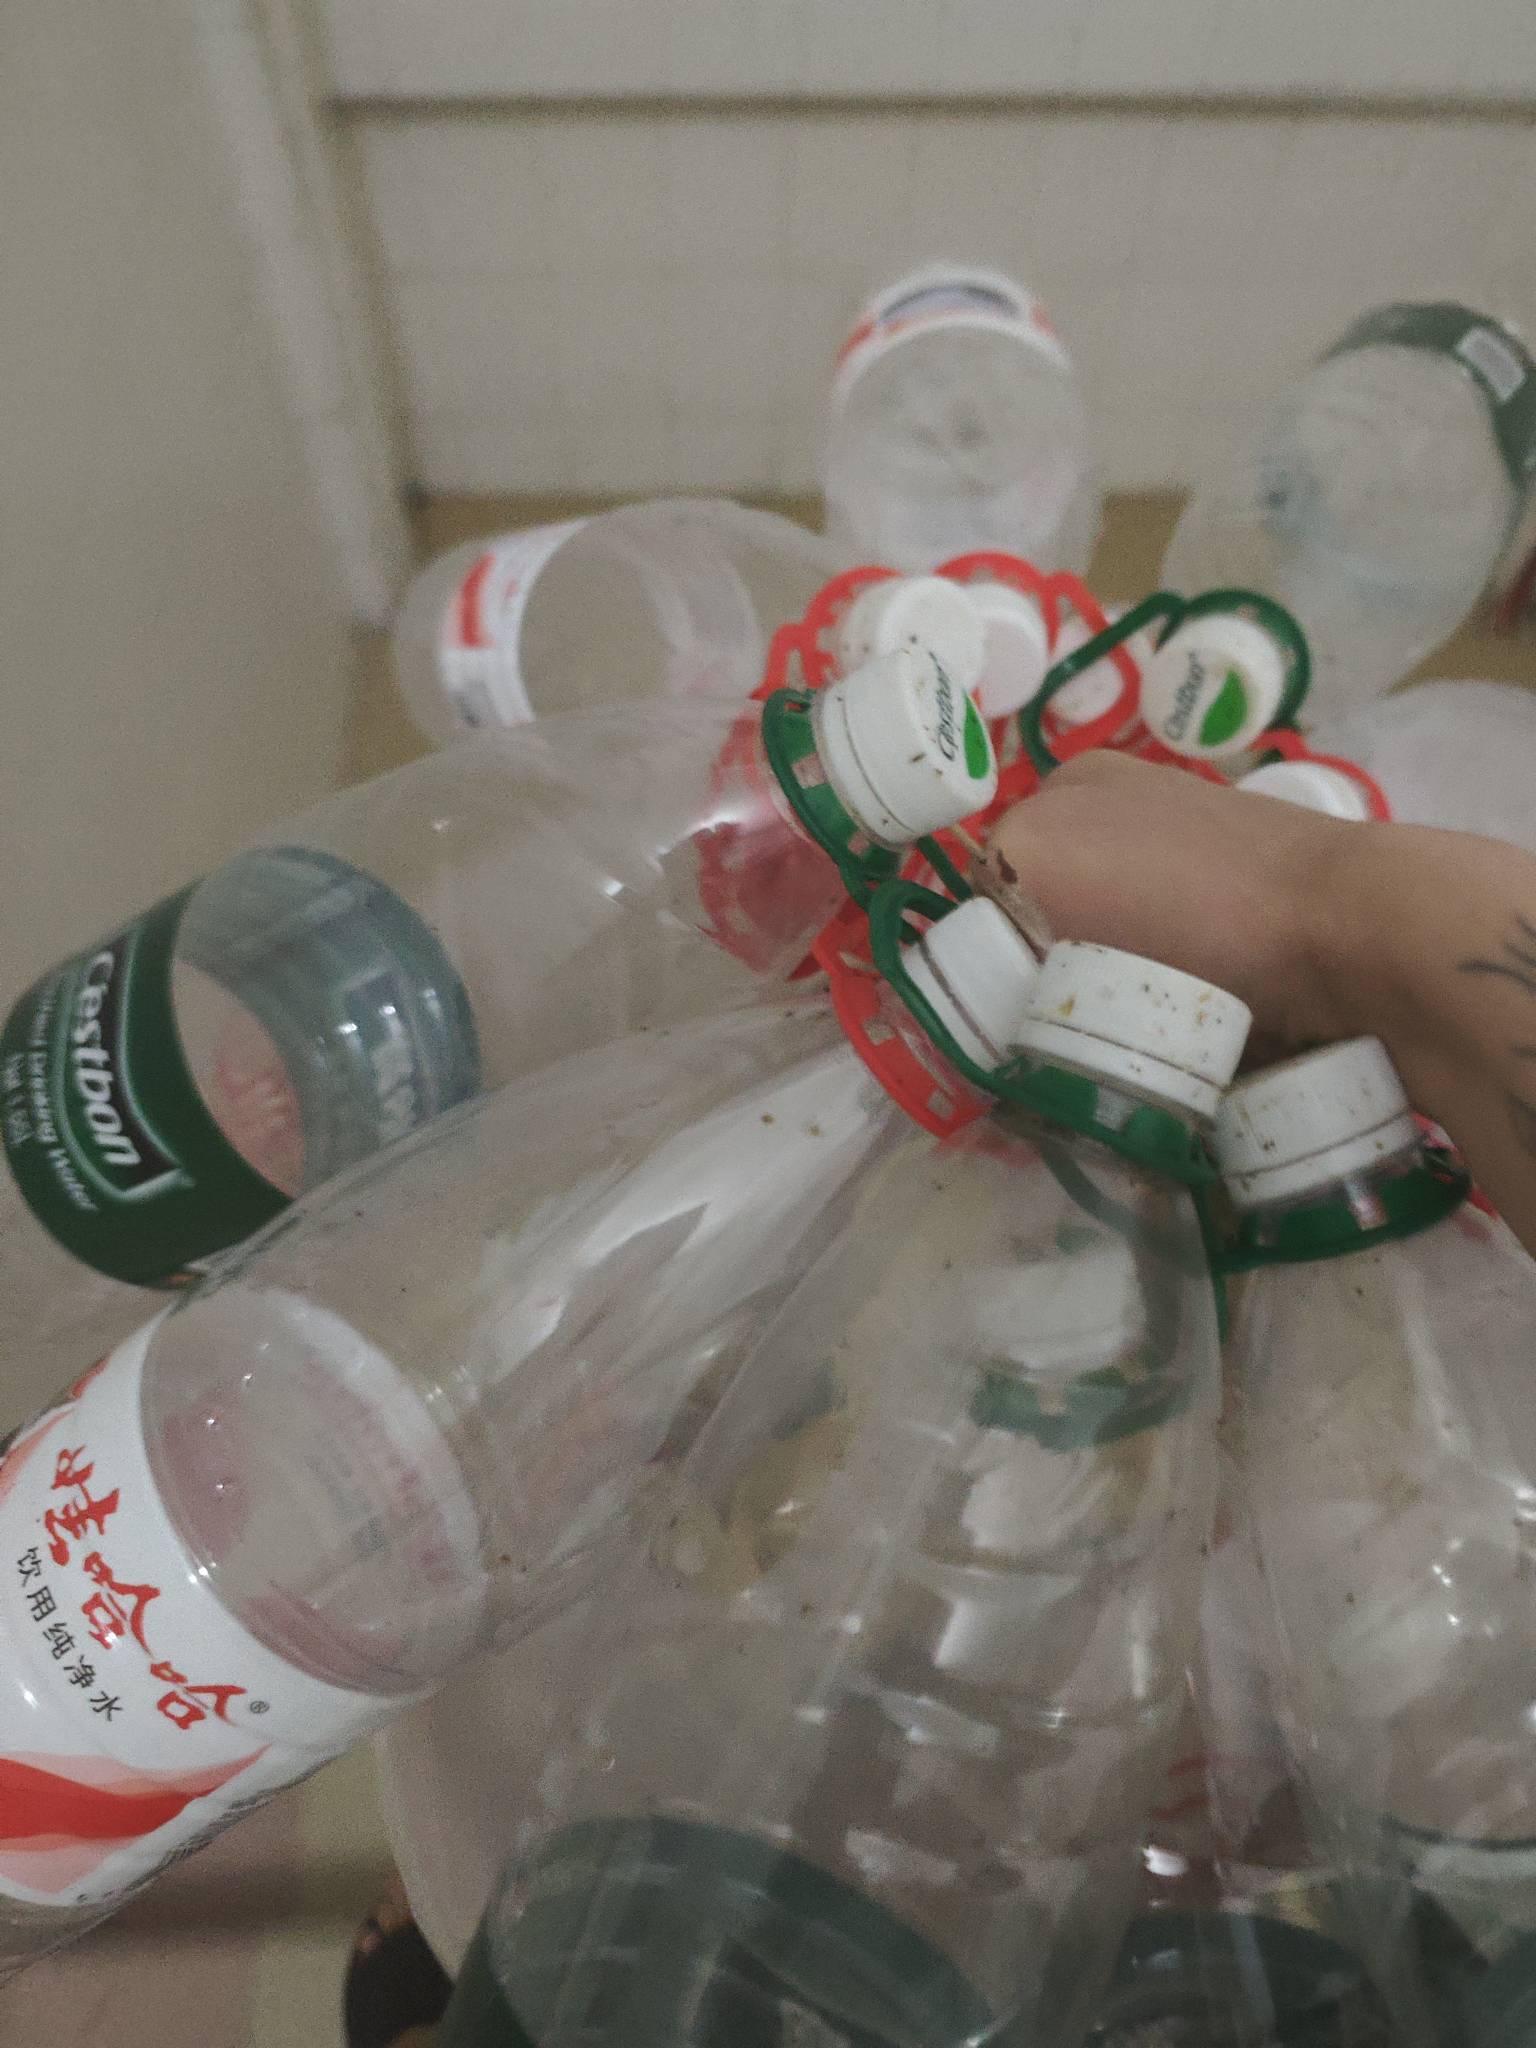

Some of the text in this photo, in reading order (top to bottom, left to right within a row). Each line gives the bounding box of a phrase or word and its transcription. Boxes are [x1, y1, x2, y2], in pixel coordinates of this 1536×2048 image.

[17, 1547, 124, 1722] 饮用纯净水
[44, 1445, 249, 1730] 娃哈哈
